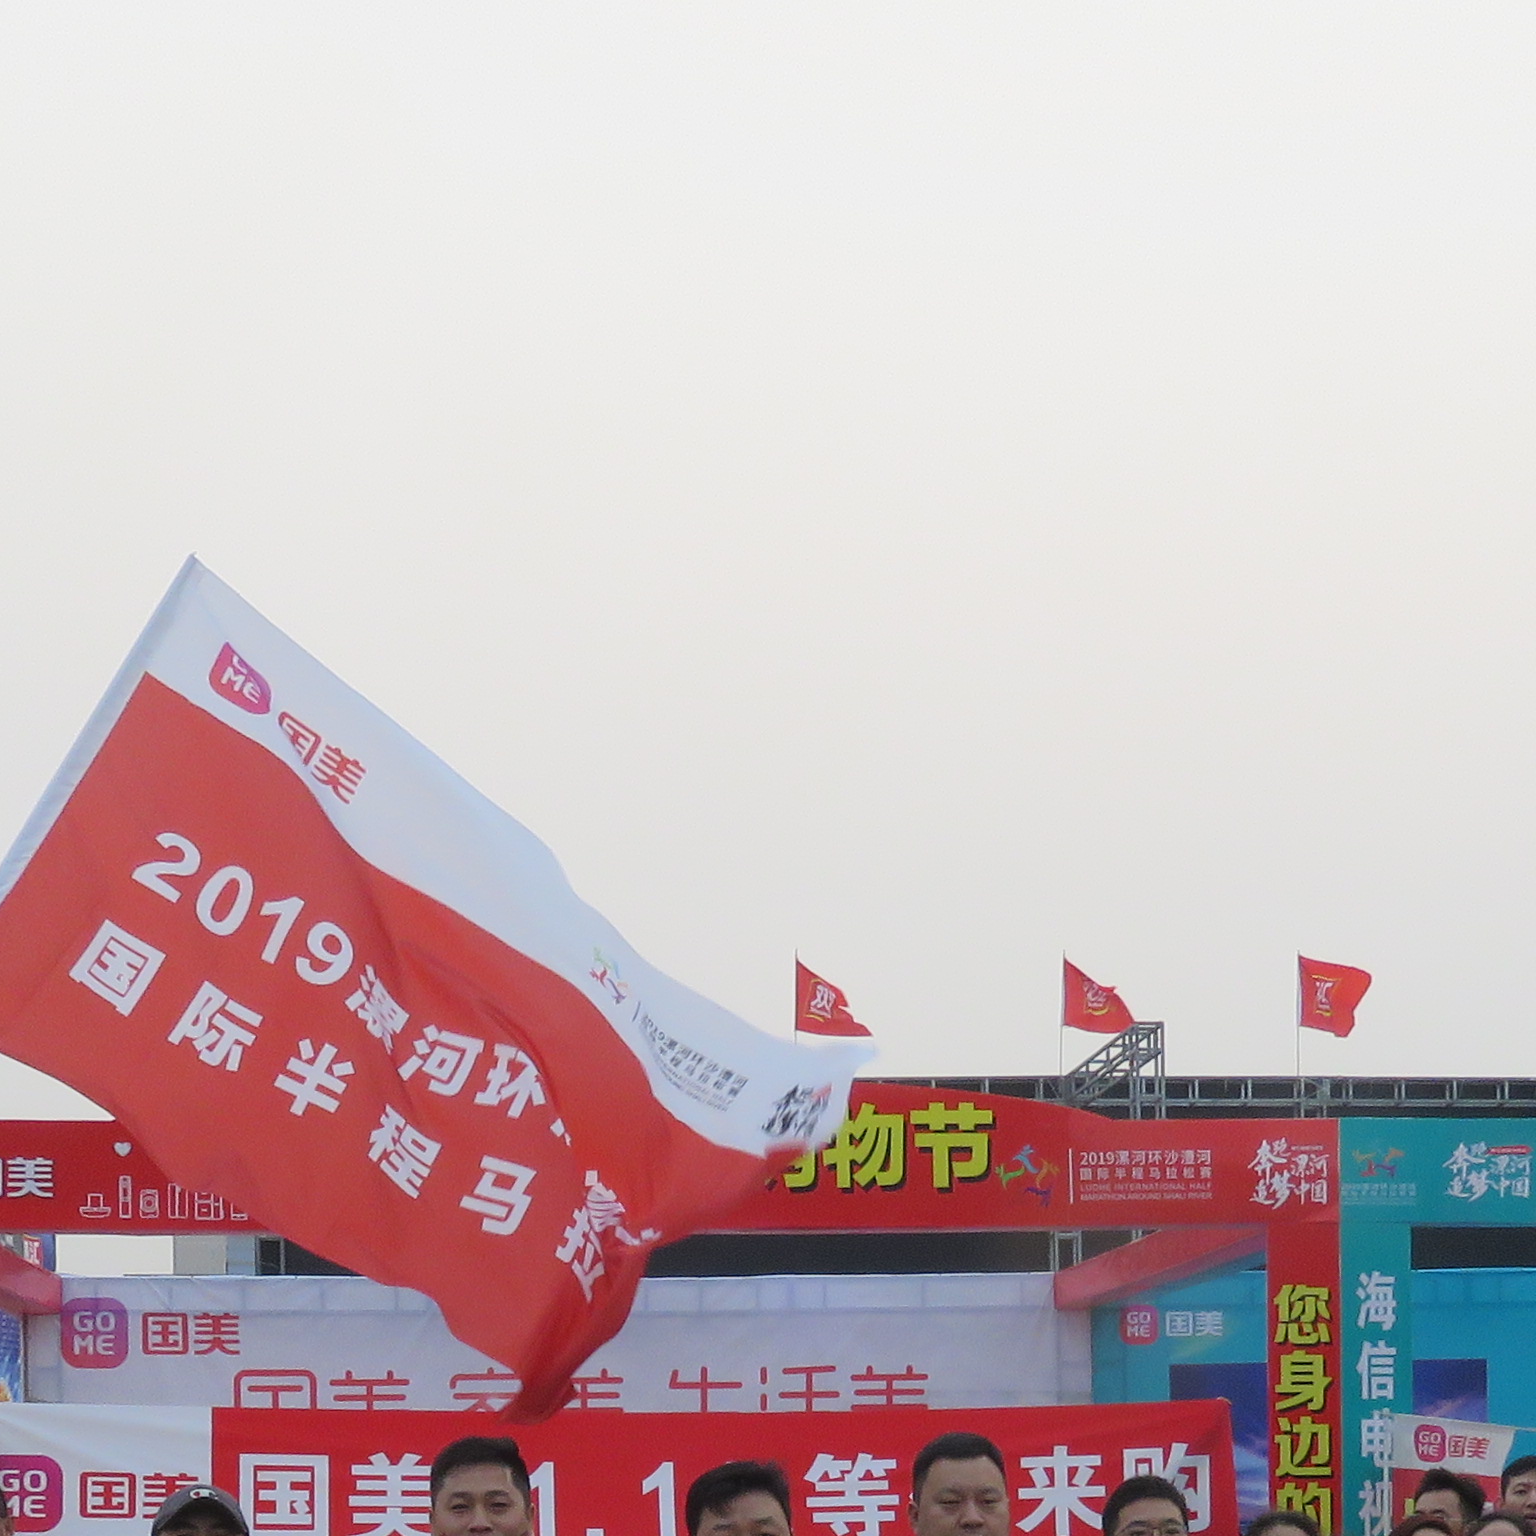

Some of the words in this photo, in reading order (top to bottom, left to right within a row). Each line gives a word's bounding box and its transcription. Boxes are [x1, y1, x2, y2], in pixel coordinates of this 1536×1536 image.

[73, 1310, 116, 1331] GO
[1165, 1310, 1224, 1337] 国美
[73, 1334, 115, 1356] ME
[141, 1312, 241, 1356] 国美
[1447, 1435, 1491, 1460] 国美
